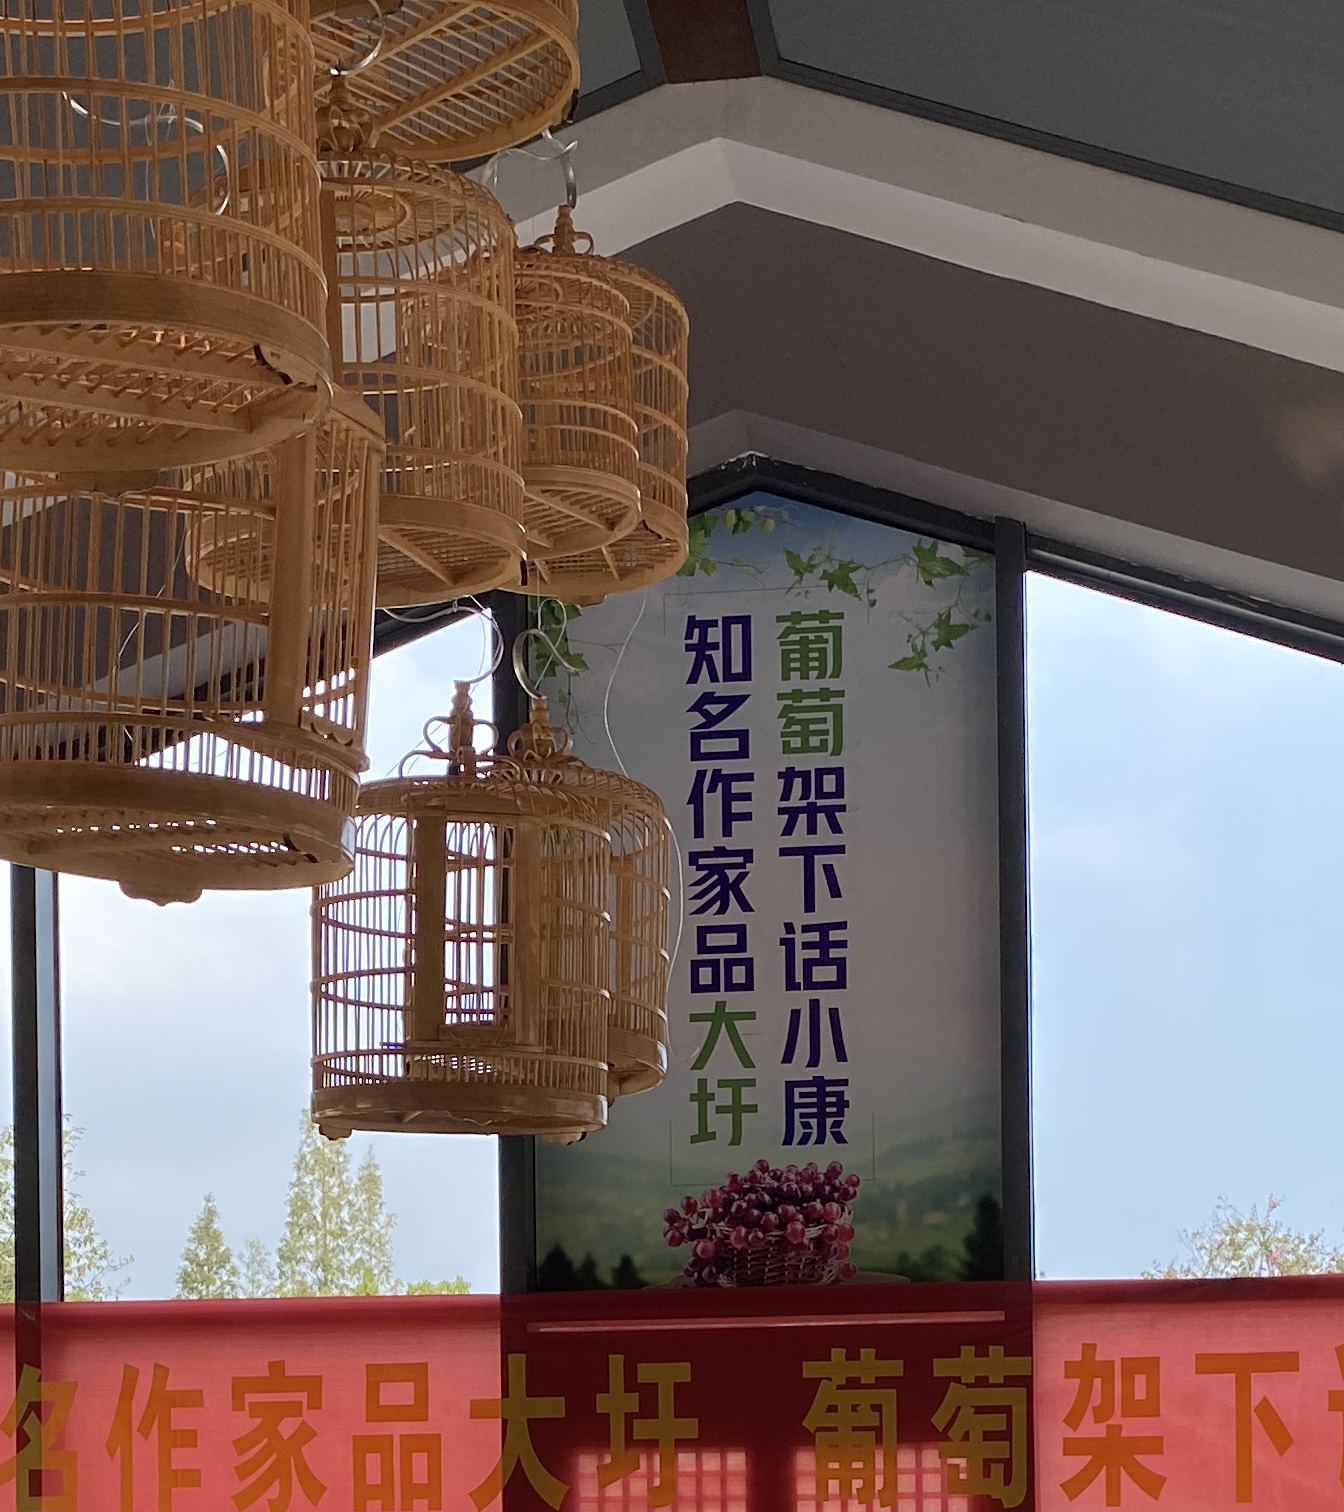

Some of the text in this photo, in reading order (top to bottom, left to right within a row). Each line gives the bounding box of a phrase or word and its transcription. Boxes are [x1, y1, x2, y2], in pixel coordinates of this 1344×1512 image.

[684, 613, 759, 1147] 知名作家品大圩
[775, 609, 850, 1147] 葡萄架下话小康
